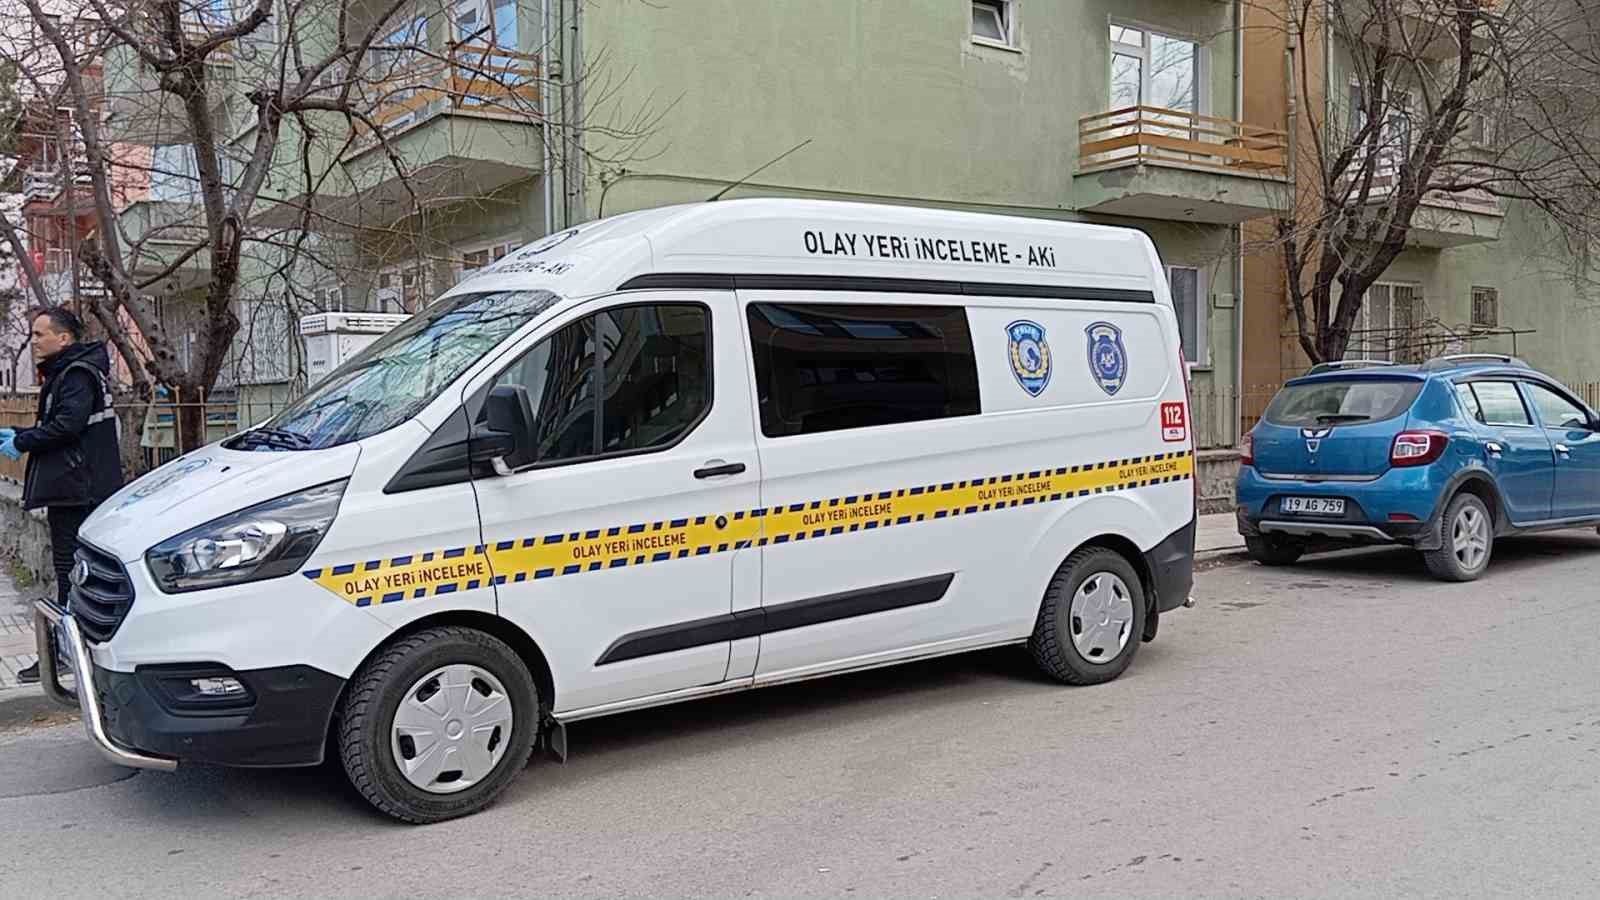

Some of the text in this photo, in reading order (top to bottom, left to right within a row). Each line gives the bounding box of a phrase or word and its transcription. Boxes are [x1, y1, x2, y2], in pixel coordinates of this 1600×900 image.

[804, 231, 856, 256] OLAY
[1164, 406, 1182, 425] 112
[978, 488, 997, 500] OLAY
[1288, 499, 1342, 512] 19 AG 759
[803, 513, 826, 525] OLAY
[573, 543, 601, 559] OLAY
[345, 577, 384, 595] OLAY
